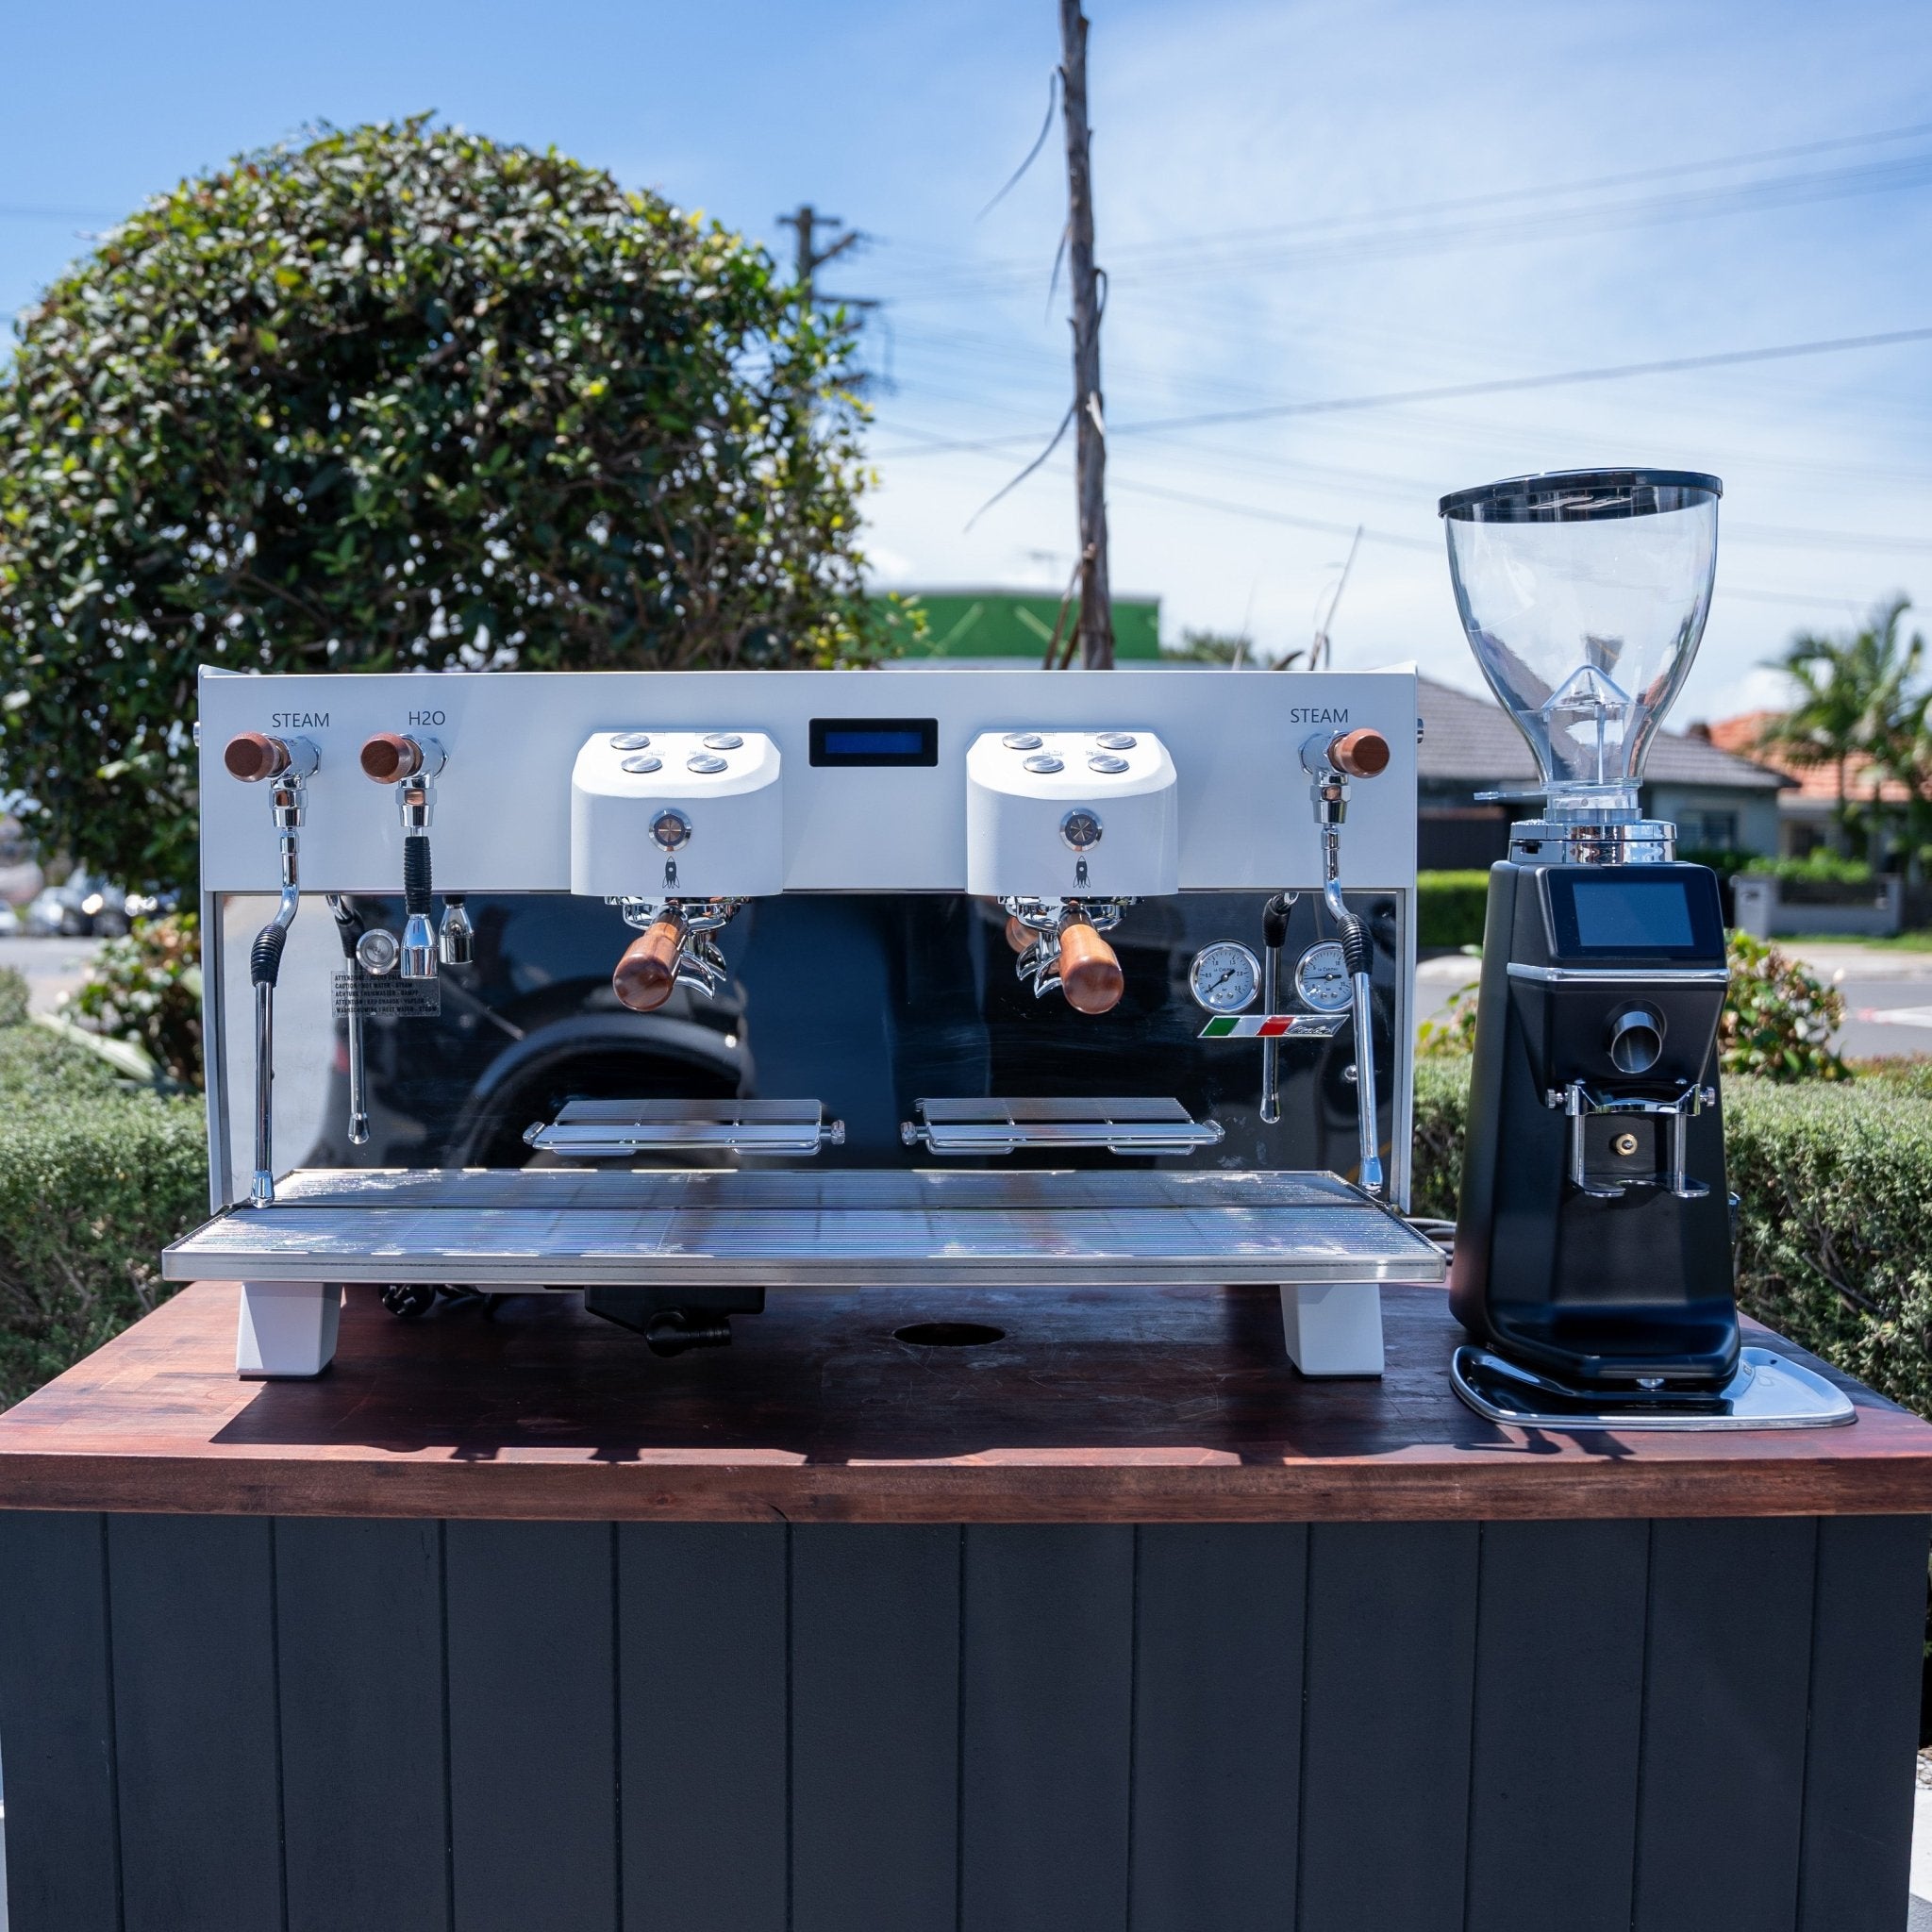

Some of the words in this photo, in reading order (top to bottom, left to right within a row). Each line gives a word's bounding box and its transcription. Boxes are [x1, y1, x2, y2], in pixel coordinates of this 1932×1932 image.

[272, 712, 329, 728] STEAM
[408, 710, 446, 725] H2O
[1290, 708, 1348, 724] STEAM
